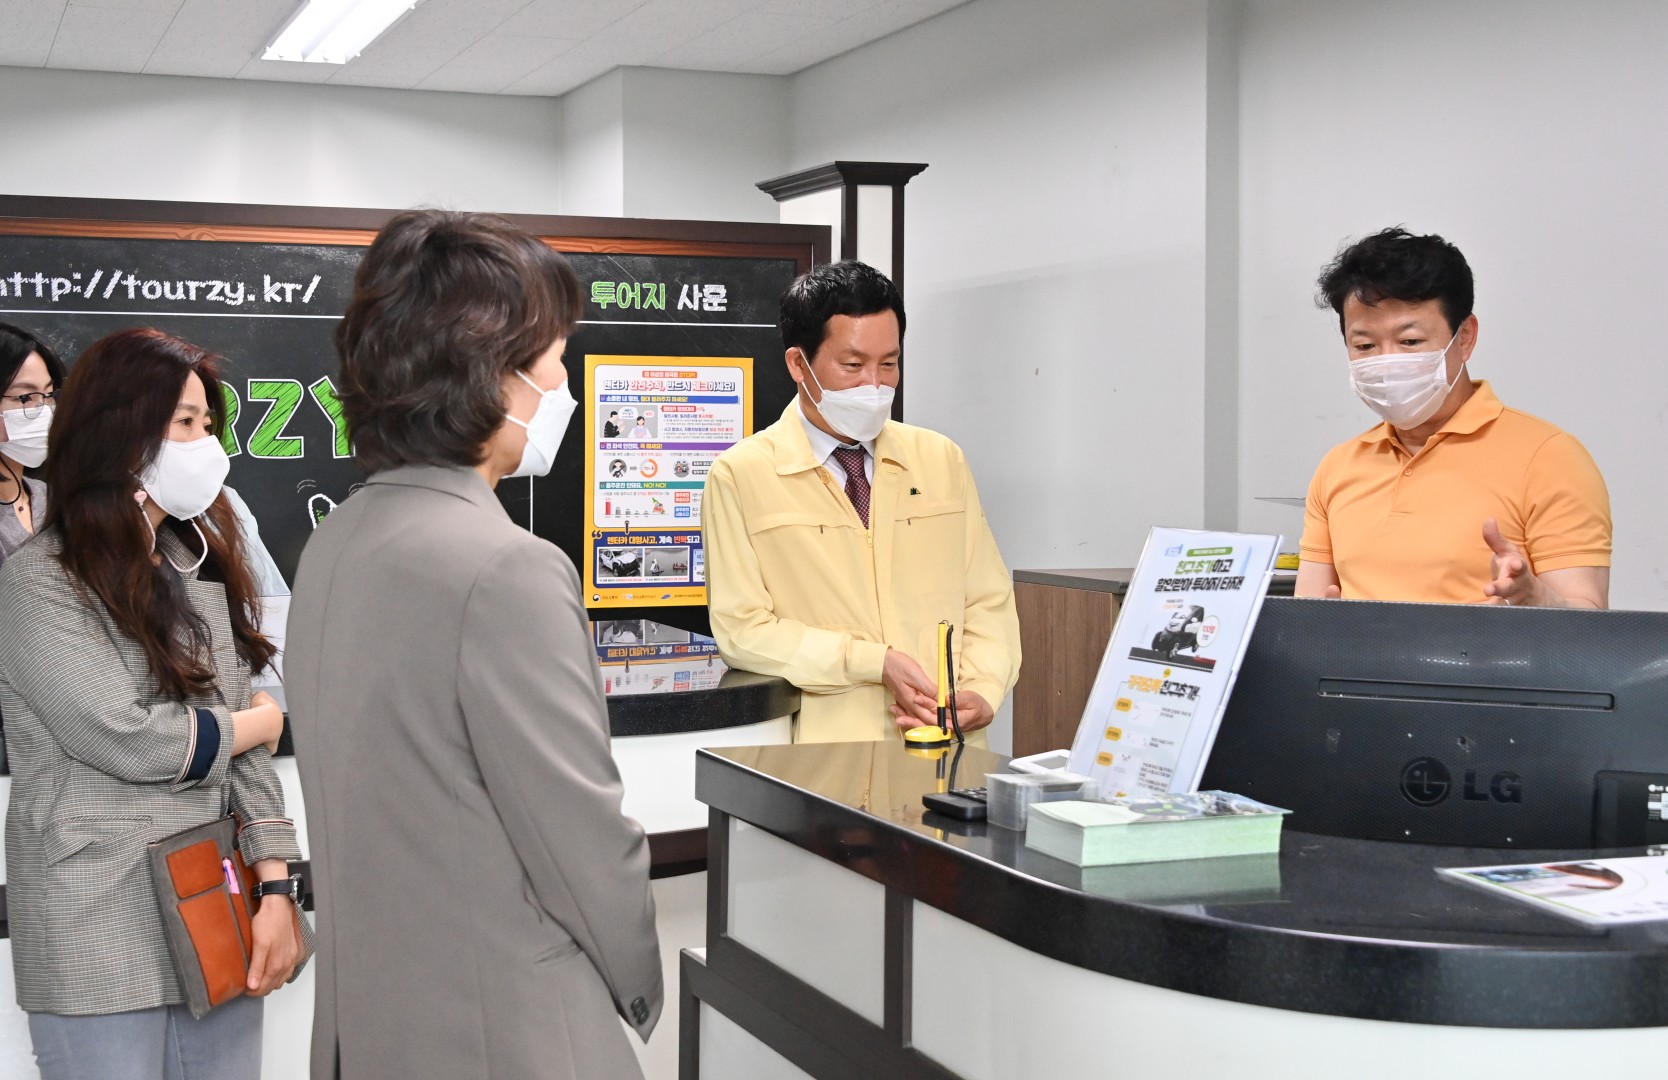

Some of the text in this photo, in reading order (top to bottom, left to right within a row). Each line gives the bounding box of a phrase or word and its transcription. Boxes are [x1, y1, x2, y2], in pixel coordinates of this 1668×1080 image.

[590, 281, 728, 312] 투어지 사훈
[603, 380, 736, 393] 렌터카 안전수칙, 반드시 체크하세요!
[607, 535, 700, 544] 렌터카 대형사고, 계속 반복되고
[1154, 578, 1193, 592] 할인받아
[1192, 576, 1222, 591] 투어지
[1463, 769, 1522, 804] LG
